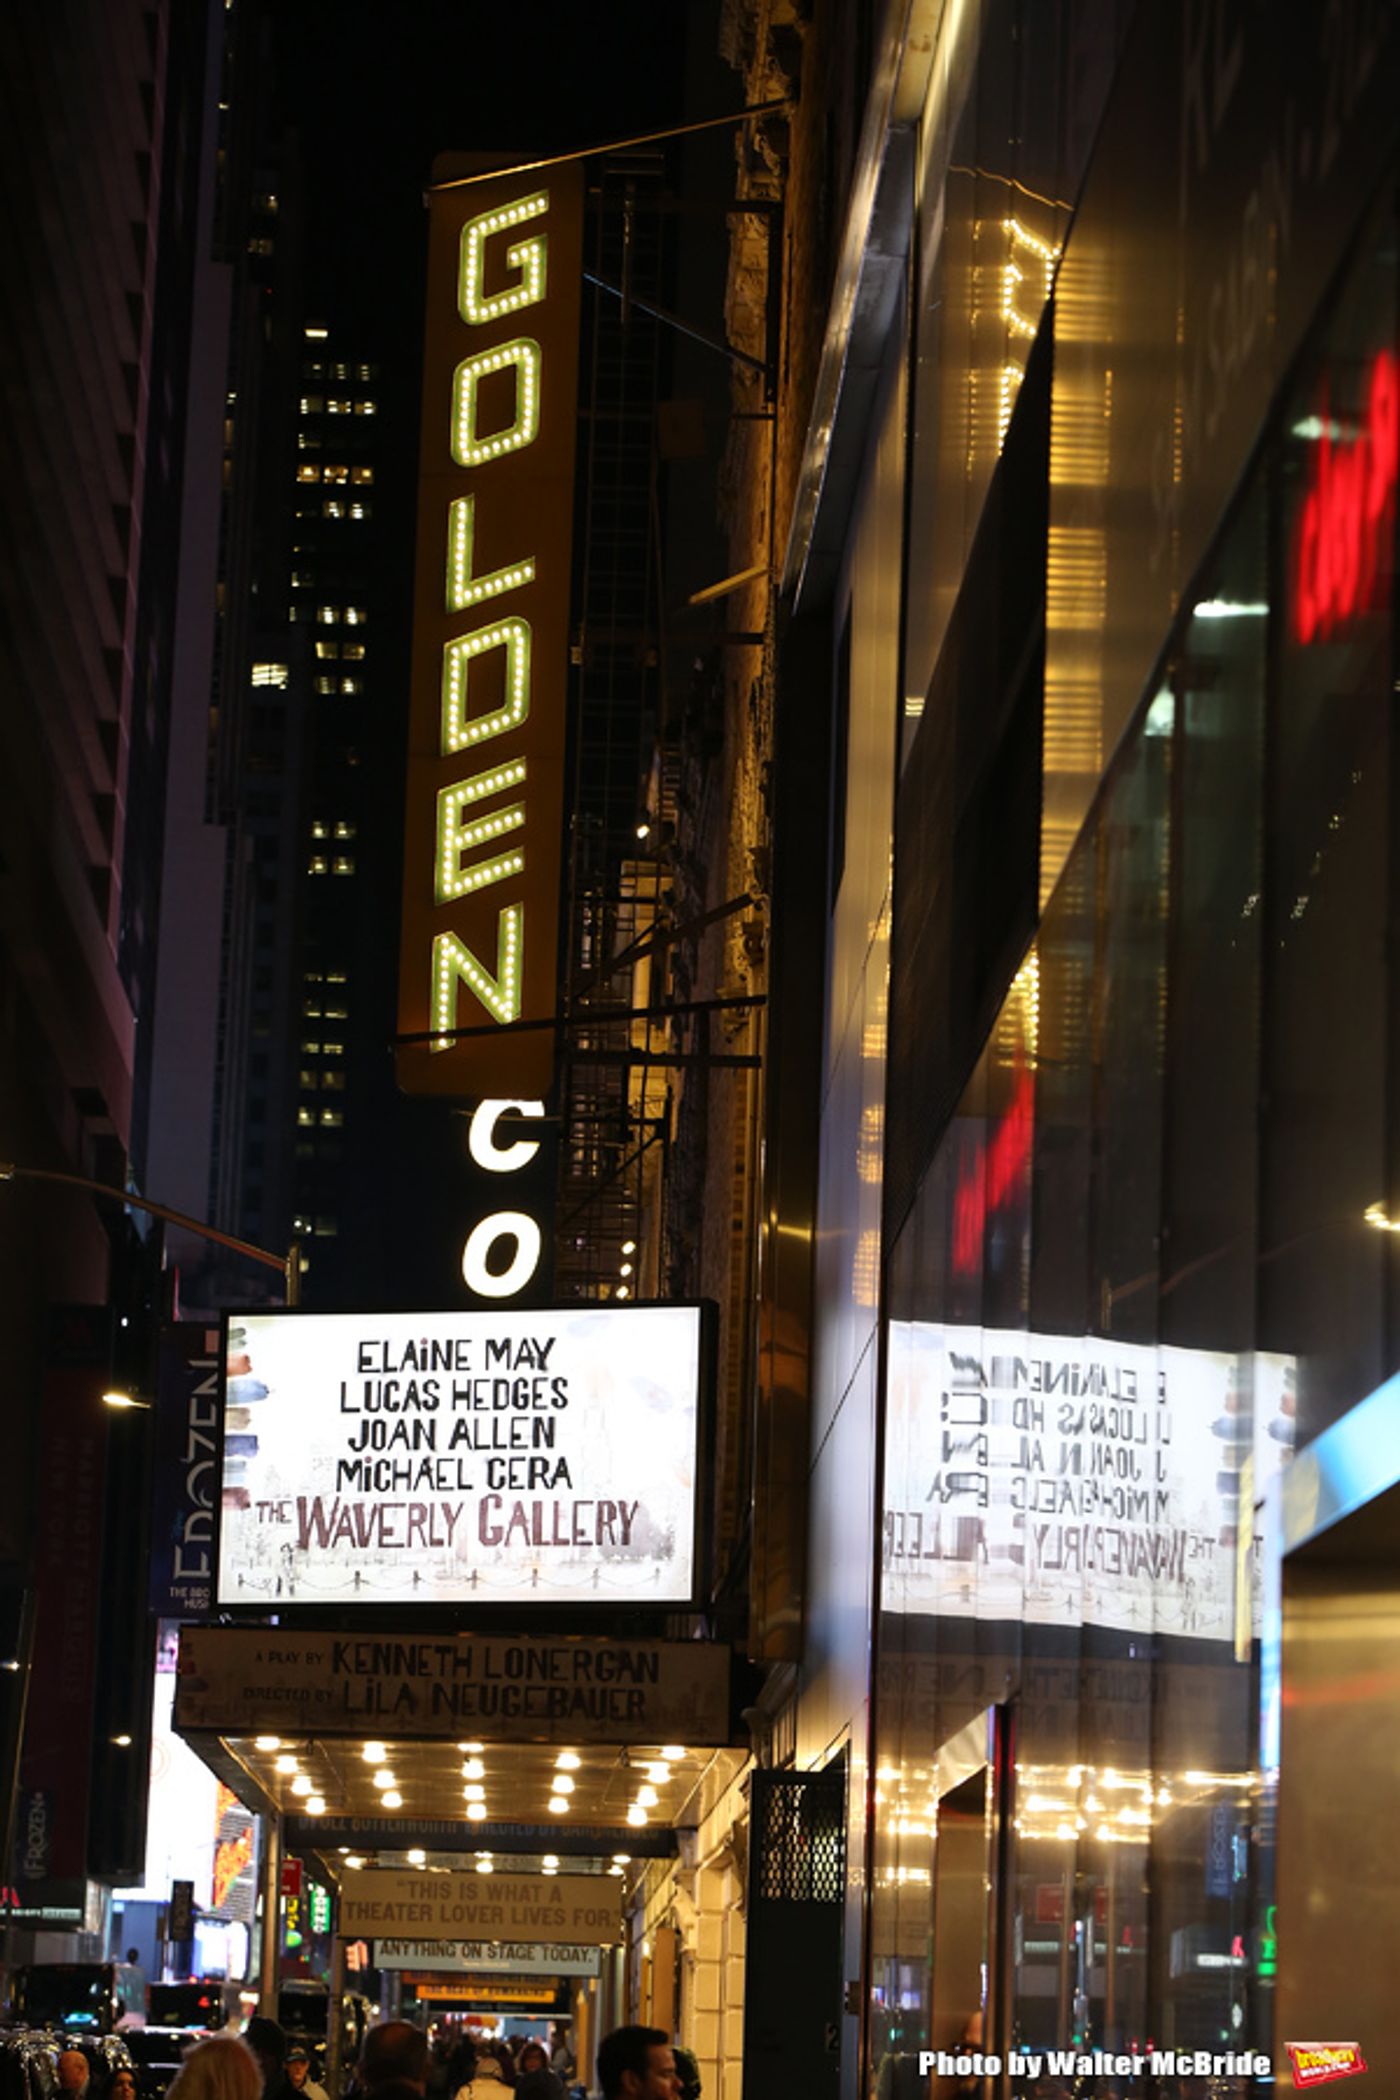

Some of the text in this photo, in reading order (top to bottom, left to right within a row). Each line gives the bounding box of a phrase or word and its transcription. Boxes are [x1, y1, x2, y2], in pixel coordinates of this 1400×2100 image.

[430, 188, 550, 1055] GOLDEN
[484, 1337, 557, 1373] MAY
[340, 1376, 570, 1414] LUCAS HEDGES
[347, 1416, 557, 1453] JOAN ALLEN
[485, 1456, 574, 1491] CERA
[255, 1493, 641, 1551] THE WAVERLY GALLERY
[255, 1641, 660, 1684] A PLAY BY KENNETH LONERGAN
[243, 1686, 310, 1701] DIRECTED
[315, 1688, 335, 1702] BY
[432, 1682, 648, 1722] NEUGEBAUER
[459, 1882, 479, 1901] IS
[486, 1884, 544, 1903] WHAT
[550, 1885, 563, 1904] A
[344, 1901, 433, 1922] THEATER
[440, 1905, 503, 1925] LOVER
[511, 1907, 567, 1927] LIVES
[380, 1940, 457, 1958] ANYTHING
[461, 1941, 483, 1959] ON
[487, 1943, 537, 1961] STAGE
